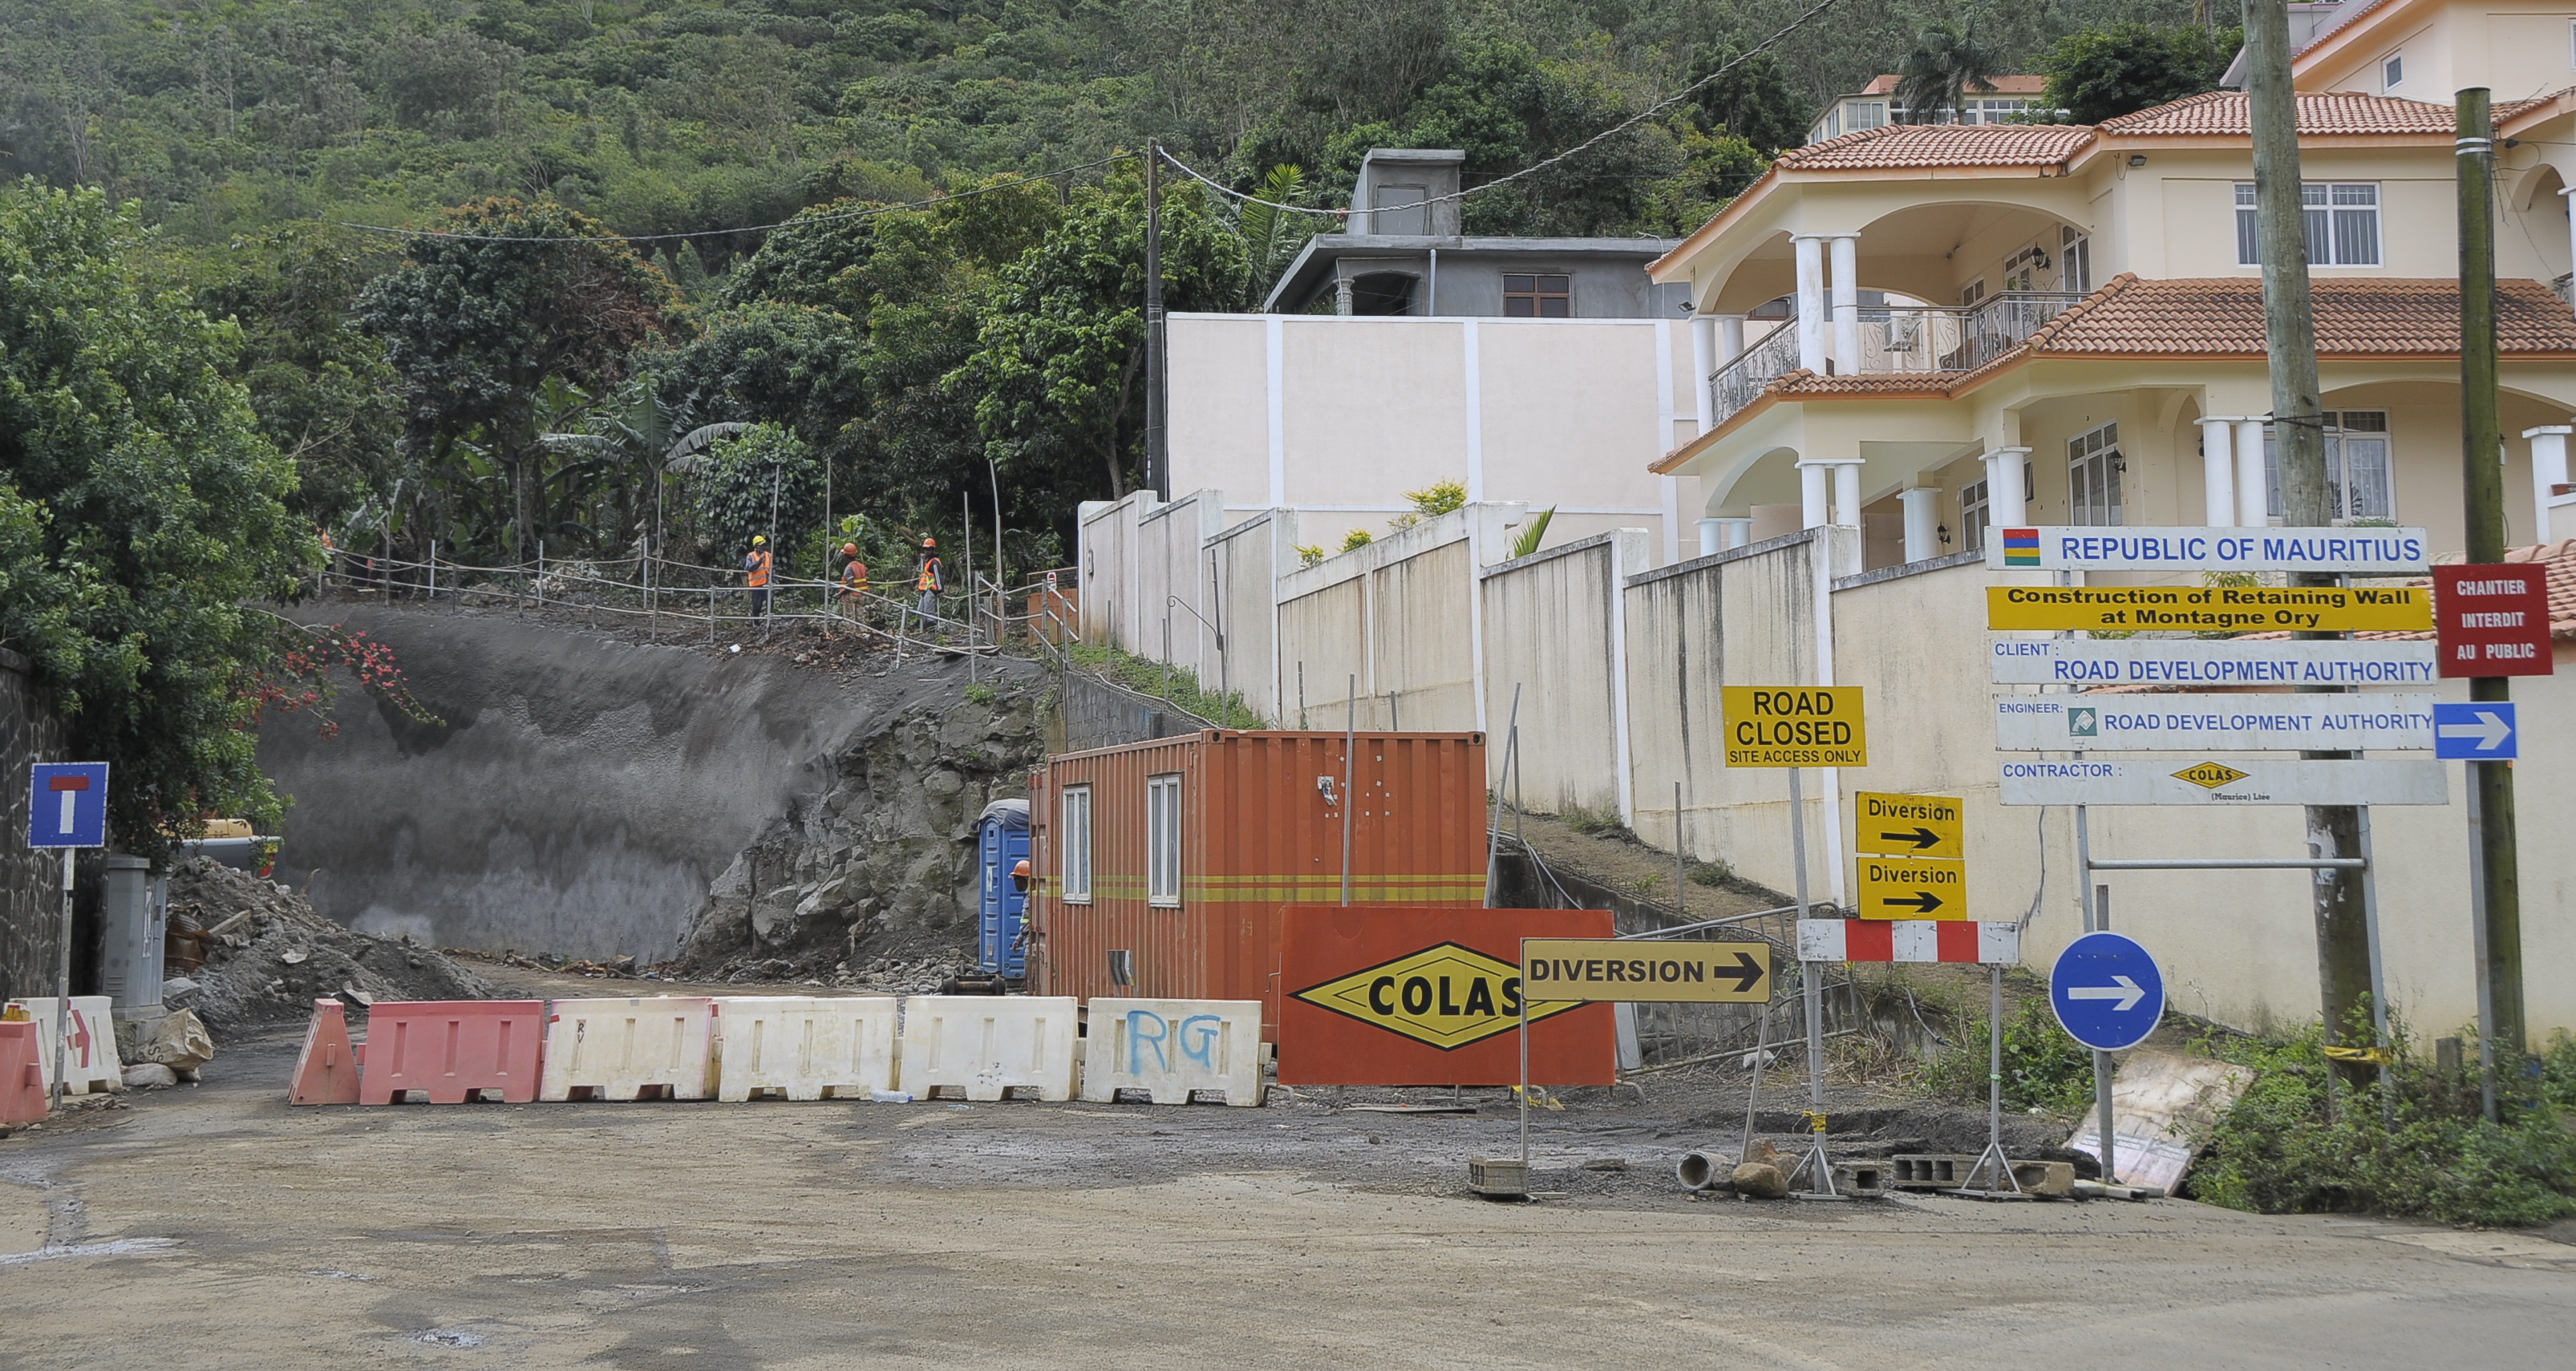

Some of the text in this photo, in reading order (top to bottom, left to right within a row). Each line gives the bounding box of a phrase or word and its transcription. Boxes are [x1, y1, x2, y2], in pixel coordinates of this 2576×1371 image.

[2062, 538, 2420, 561] REPUBLIC OF MAURITIUS
[2457, 580, 2526, 596] CHANTIER
[2007, 588, 2410, 609] Construction of Retaining Wall
[2100, 609, 2320, 628] at Montagne Ory
[2461, 612, 2525, 628] INTERDIT
[2457, 643, 2535, 660] AU PUBLIC
[2054, 660, 2433, 681] ROAD DEVELOPMENT AUTHORITY
[1754, 691, 1834, 716] ROAD
[1999, 703, 2064, 714] ENGINEER:
[2104, 714, 2432, 730] ROAD DEVELOPMENT AUTHORITY
[1736, 721, 1851, 746] CLOSED
[1729, 750, 1861, 762] SITE ACCESS ONLY
[2189, 770, 2233, 781] COLAS
[2211, 792, 2251, 801] (Maurice)
[1868, 799, 1955, 822] Diversion
[1869, 864, 1958, 884] Diversion
[1530, 958, 1704, 982] DIVERSION
